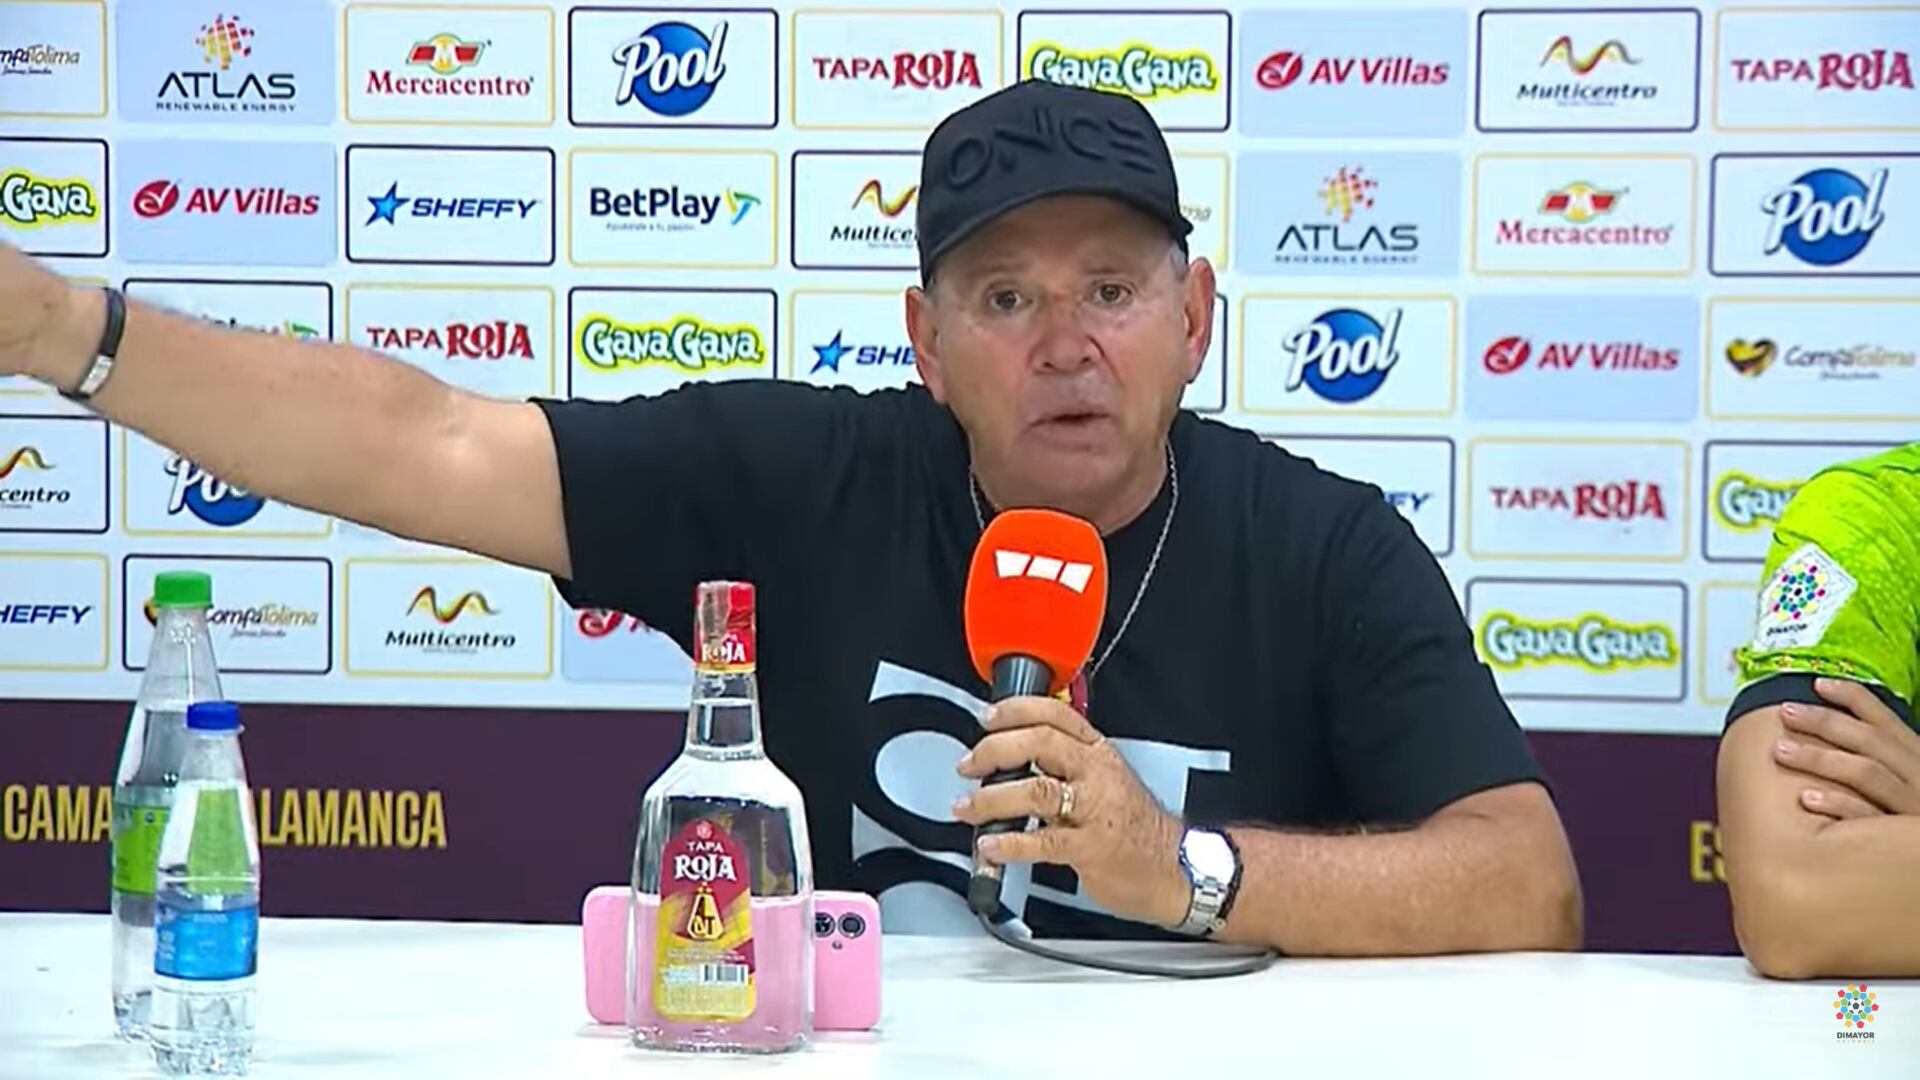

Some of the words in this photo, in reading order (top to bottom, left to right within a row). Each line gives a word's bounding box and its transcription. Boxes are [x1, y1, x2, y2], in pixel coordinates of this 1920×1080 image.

[612, 20, 729, 105] Pool
[812, 58, 889, 81] TAPA
[892, 49, 983, 90] ROJA
[1308, 59, 1358, 85] AV
[1360, 57, 1449, 86] Villas
[1731, 59, 1814, 82] TAPA
[1817, 49, 1916, 91] ROJA
[157, 72, 296, 99] ATLAS
[366, 70, 530, 96] Mercacentro
[1517, 82, 1658, 101] Multicentro
[0, 172, 95, 224] Gana
[186, 188, 230, 215] AV
[232, 187, 319, 216] Villas
[411, 197, 537, 219] SHEFFY
[589, 186, 721, 225] BetPlay
[1761, 167, 1889, 256] Pool
[830, 225, 918, 242] Multice
[1276, 225, 1418, 252] ATLAS
[1495, 220, 1670, 246] Mercacentro
[366, 327, 440, 349] TAPA
[445, 321, 534, 360] ROJA
[1282, 308, 1403, 393] Pool
[1537, 343, 1584, 370] AV
[1586, 341, 1680, 371] Villas
[163, 457, 249, 515] Po
[1489, 487, 1570, 510] TAPA
[1573, 480, 1667, 522] ROJA
[385, 630, 516, 648] Multicentro
[249, 788, 447, 848] LAMANCA
[687, 841, 724, 853] TAPA
[674, 854, 737, 882] ROJA
